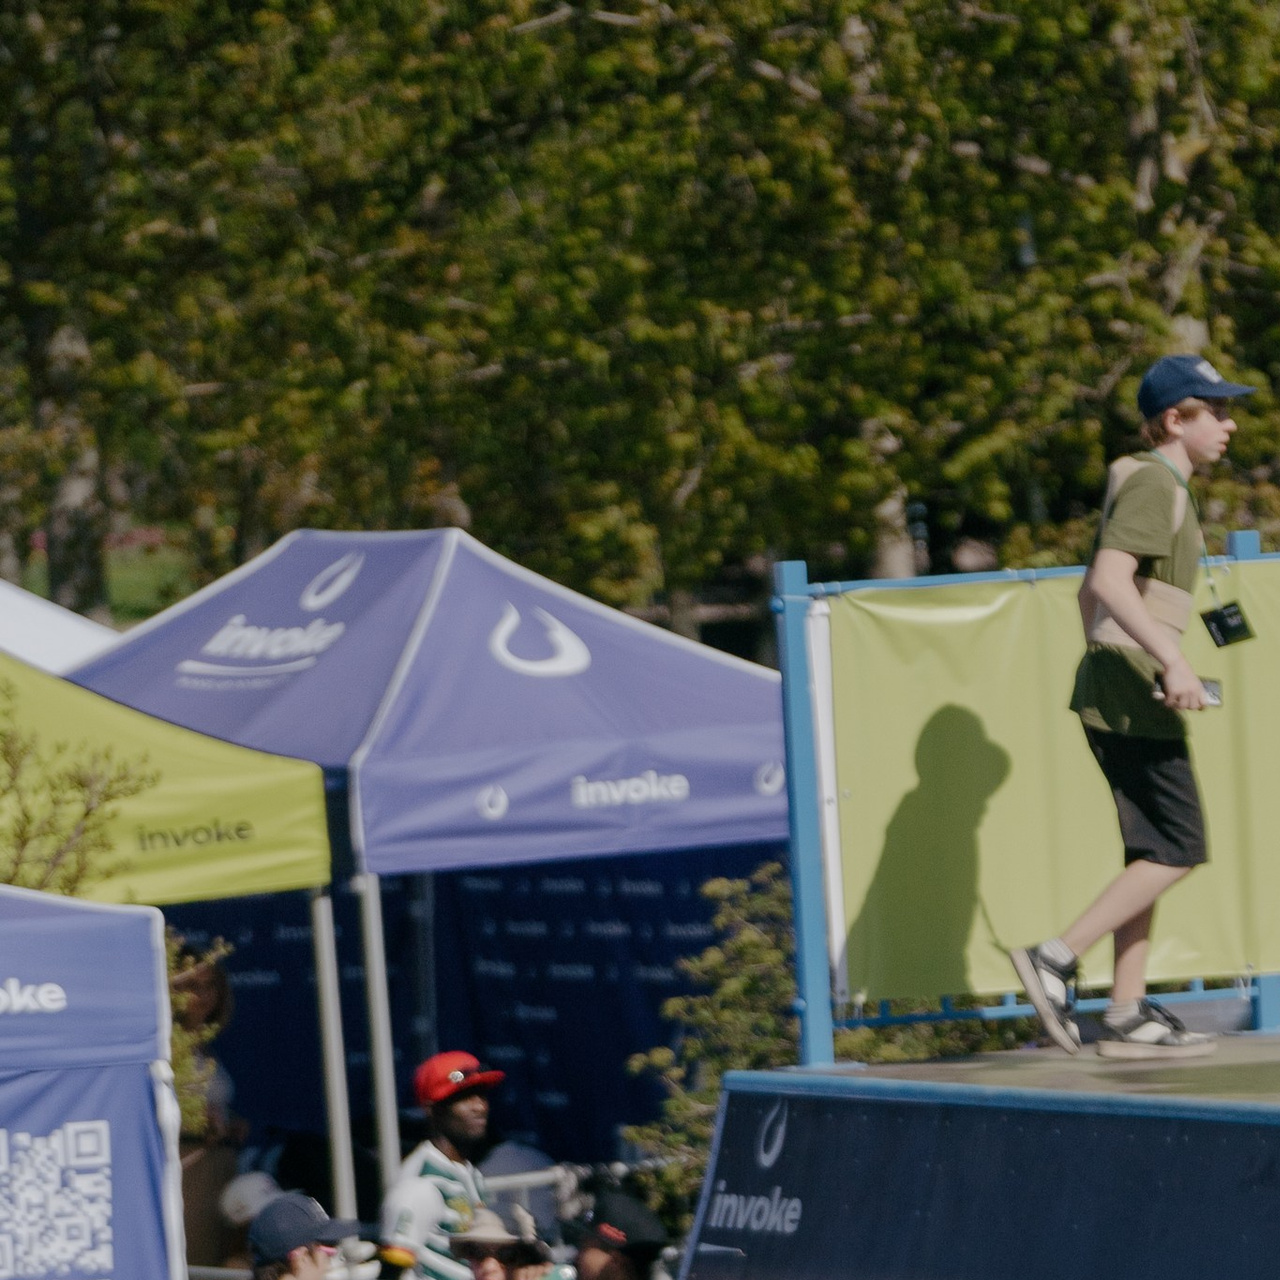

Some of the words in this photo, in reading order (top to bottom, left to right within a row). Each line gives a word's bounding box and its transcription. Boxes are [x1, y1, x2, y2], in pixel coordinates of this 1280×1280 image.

[203, 613, 346, 660] invoke
[570, 769, 691, 809] invoke
[136, 818, 255, 852] invoke
[709, 1179, 803, 1234] invoke
